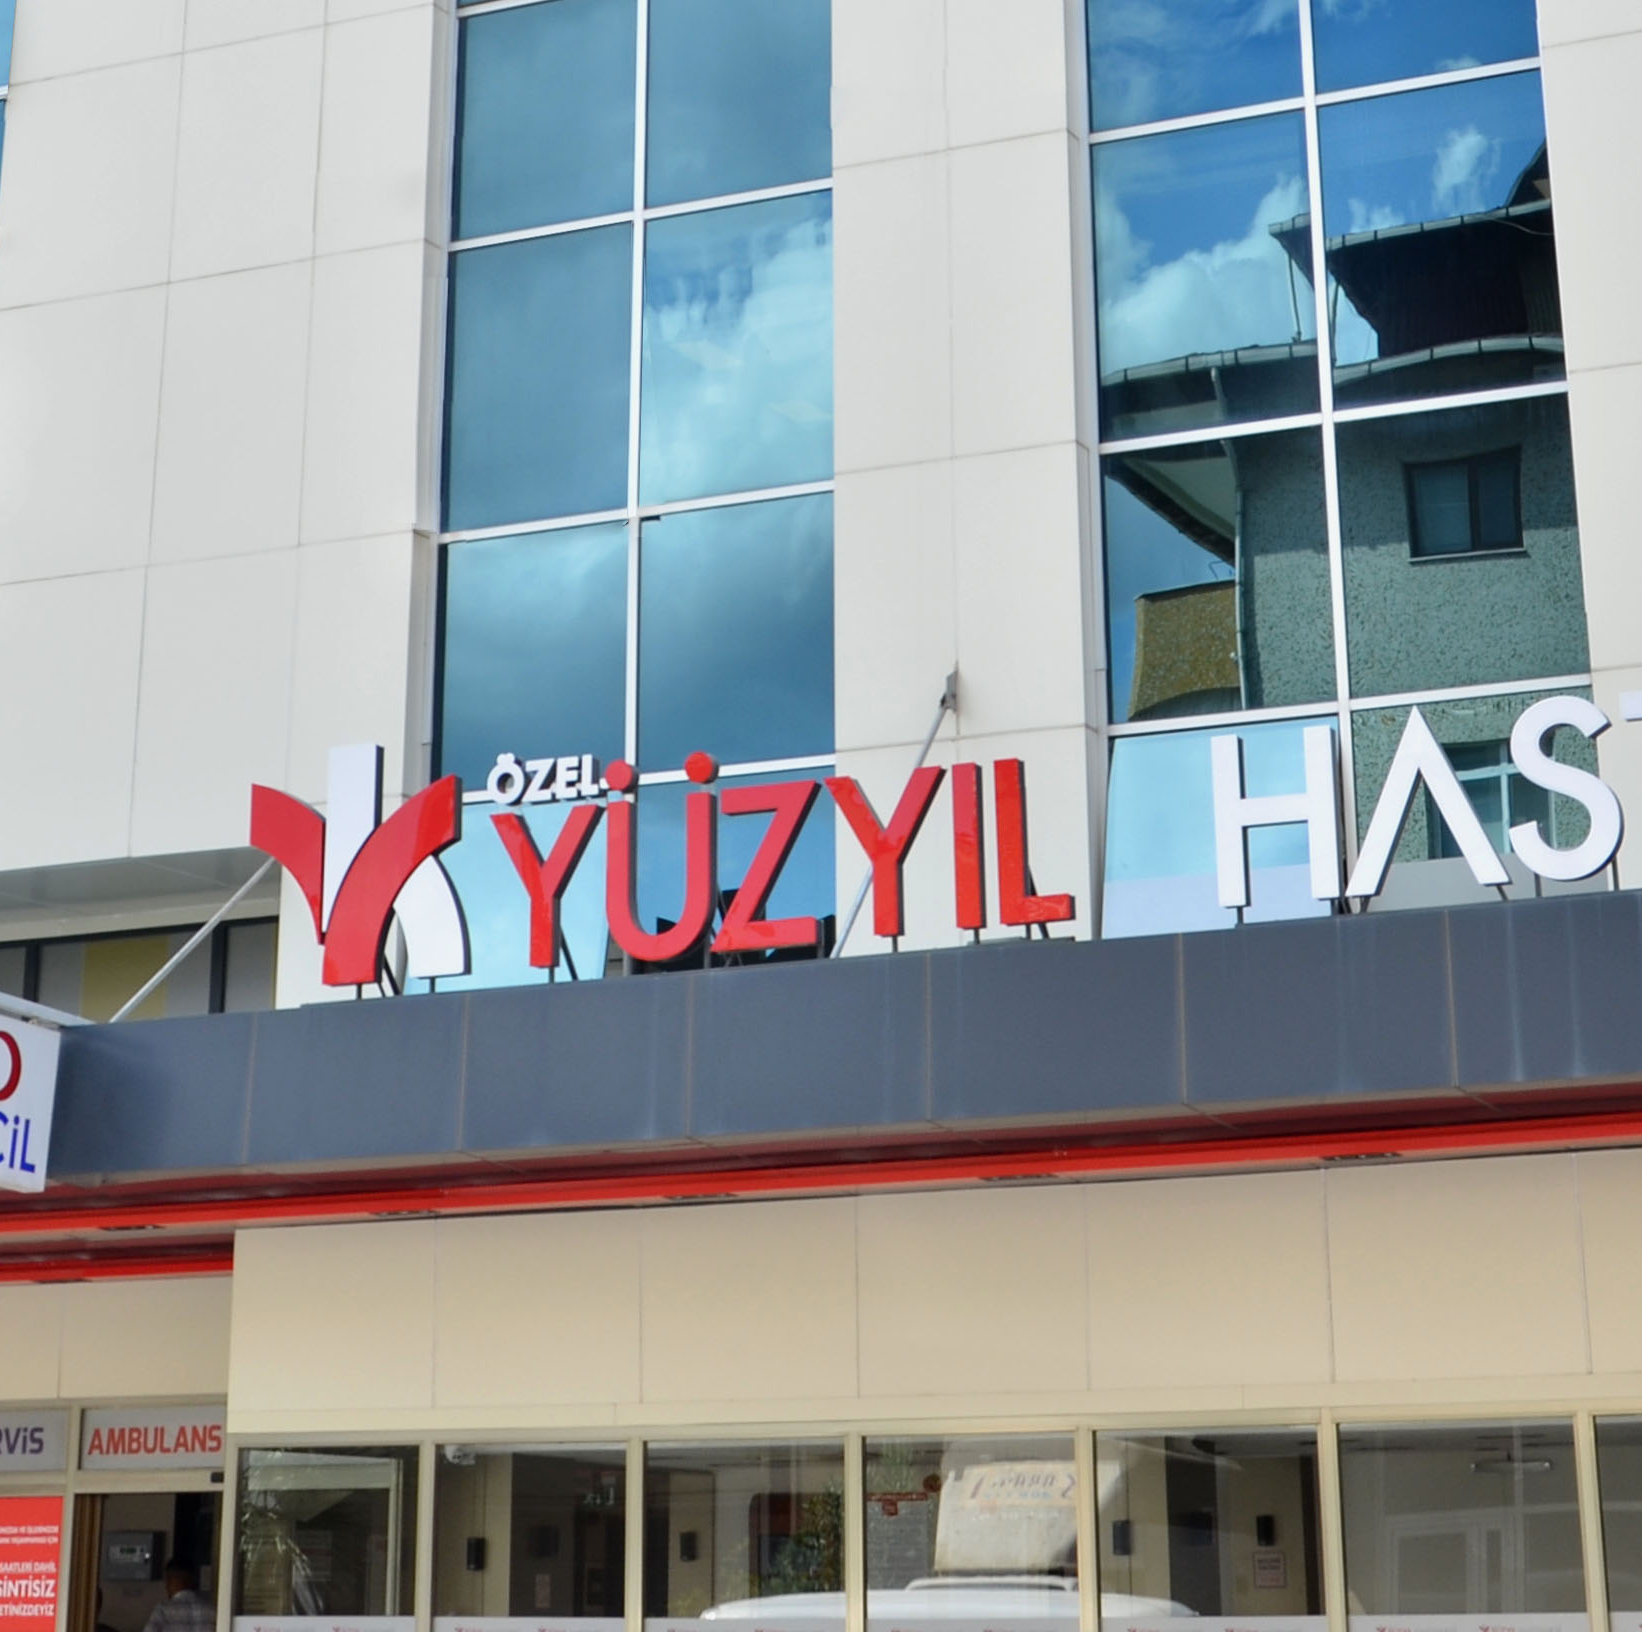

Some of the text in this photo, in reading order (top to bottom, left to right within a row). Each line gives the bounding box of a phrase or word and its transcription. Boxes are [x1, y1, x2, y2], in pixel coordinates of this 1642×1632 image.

[487, 752, 599, 805] ÖZEL
[489, 751, 1077, 968] YÜZYIL
[87, 1424, 223, 1456] AMBULANS
